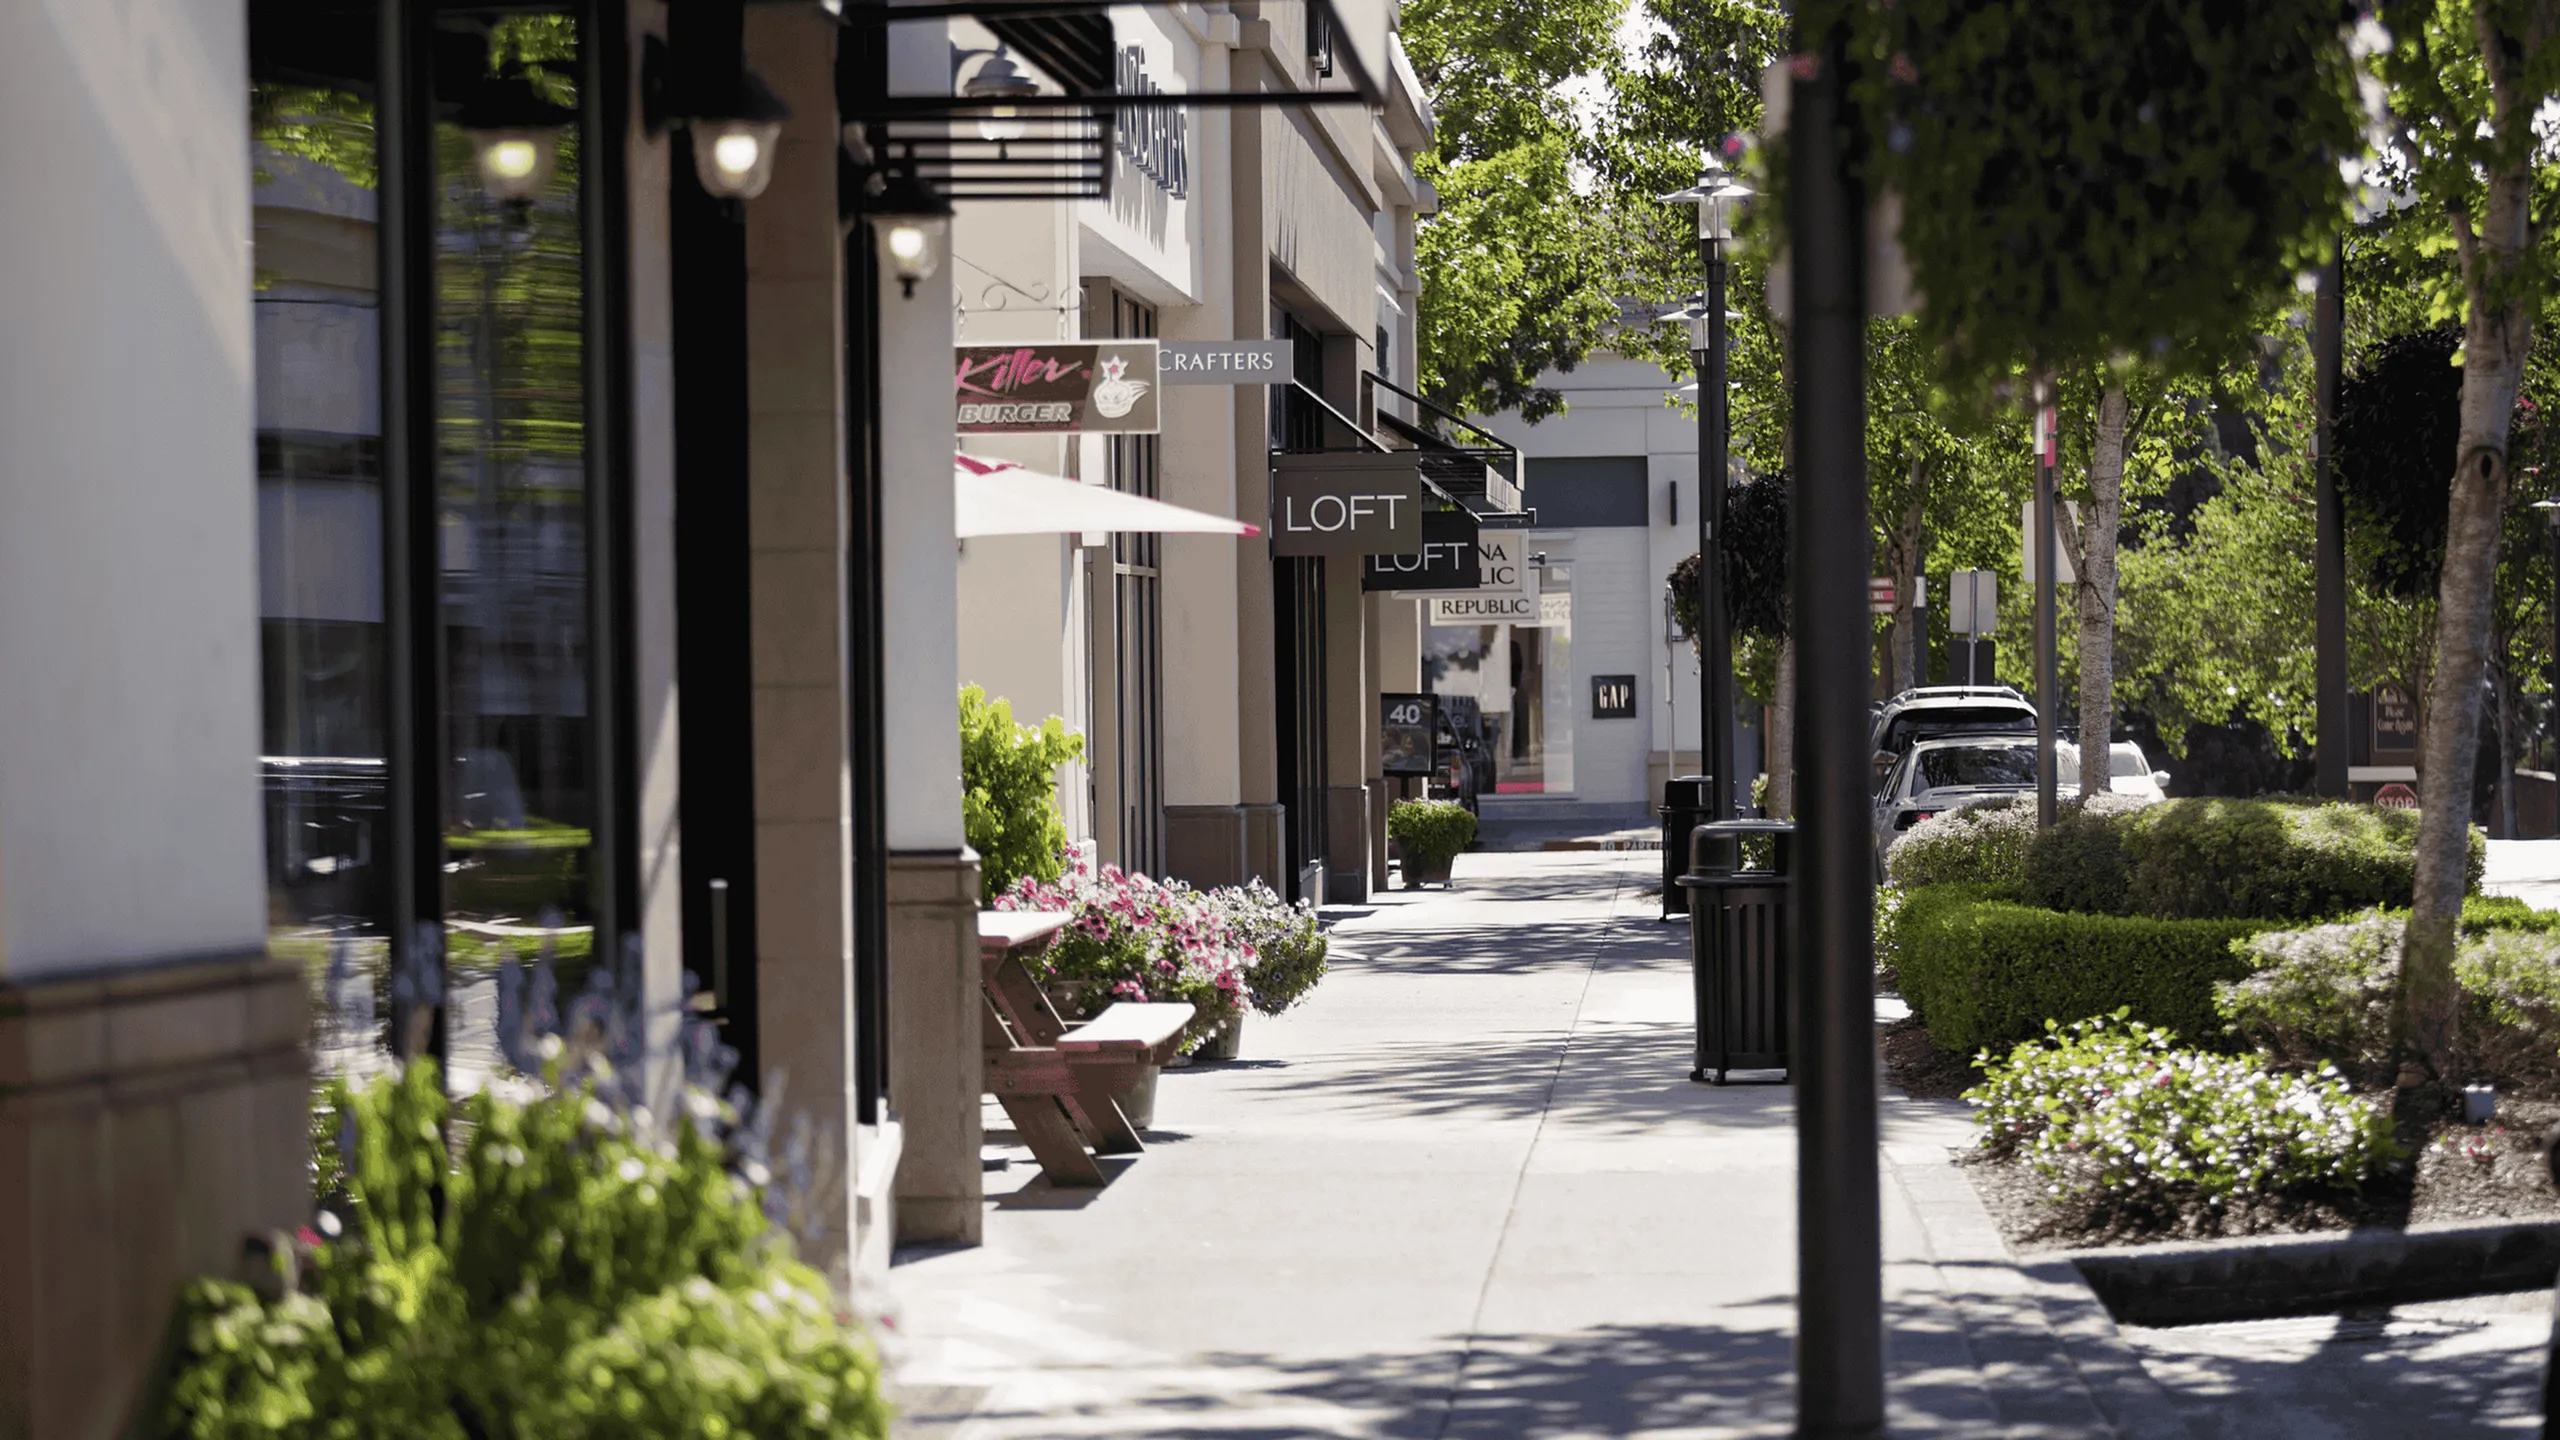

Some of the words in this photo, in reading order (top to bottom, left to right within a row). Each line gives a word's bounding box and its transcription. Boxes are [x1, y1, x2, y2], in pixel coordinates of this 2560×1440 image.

[956, 349, 1082, 397] Killer
[957, 402, 1072, 424] BURGER
[1286, 495, 1407, 531] LOFT
[1374, 543, 1468, 572] LOFT
[1441, 599, 1530, 615] REPUBLIC
[1599, 684, 1629, 709] GAP
[1389, 703, 1421, 724] 40
[2377, 796, 2414, 808] STOP
